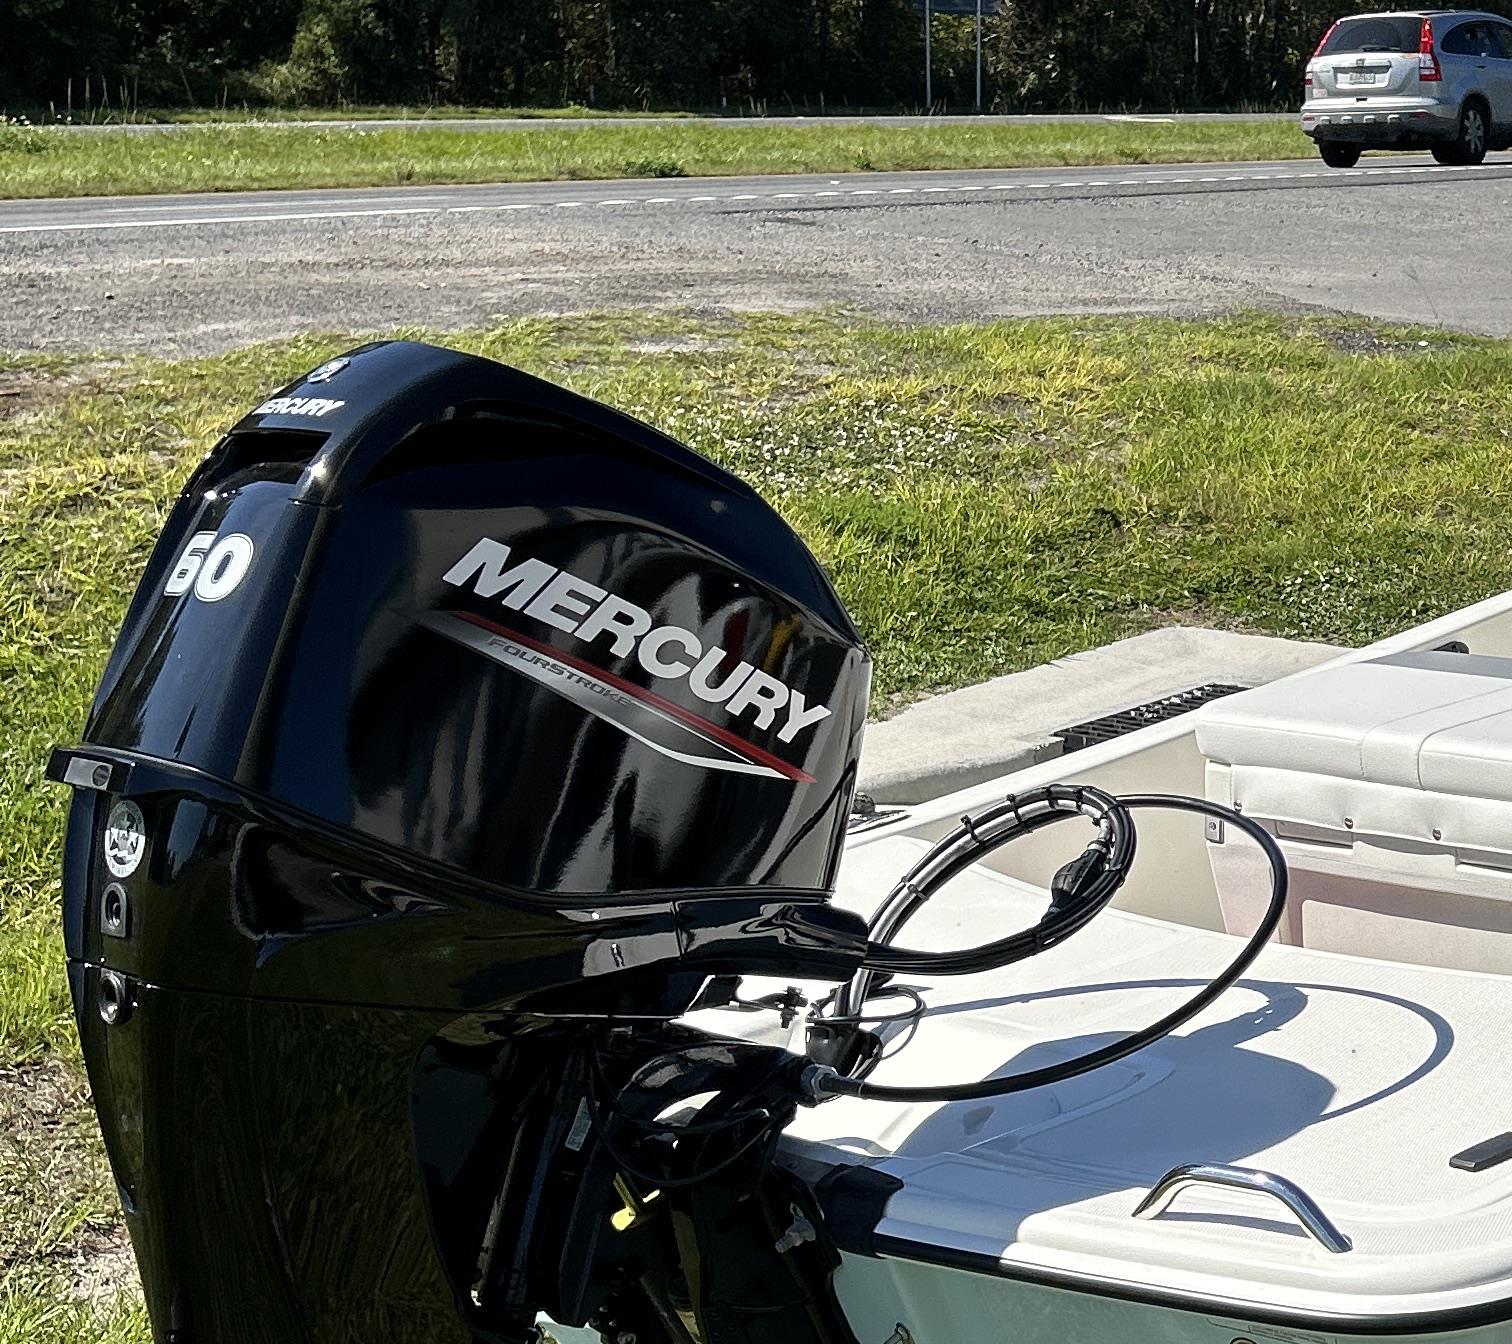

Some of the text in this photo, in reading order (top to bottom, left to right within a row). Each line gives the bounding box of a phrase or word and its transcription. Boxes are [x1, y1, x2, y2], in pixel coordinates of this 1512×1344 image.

[163, 530, 254, 602] 60
[442, 537, 832, 743] MERCURY
[486, 634, 635, 709] FOURSTROKE
